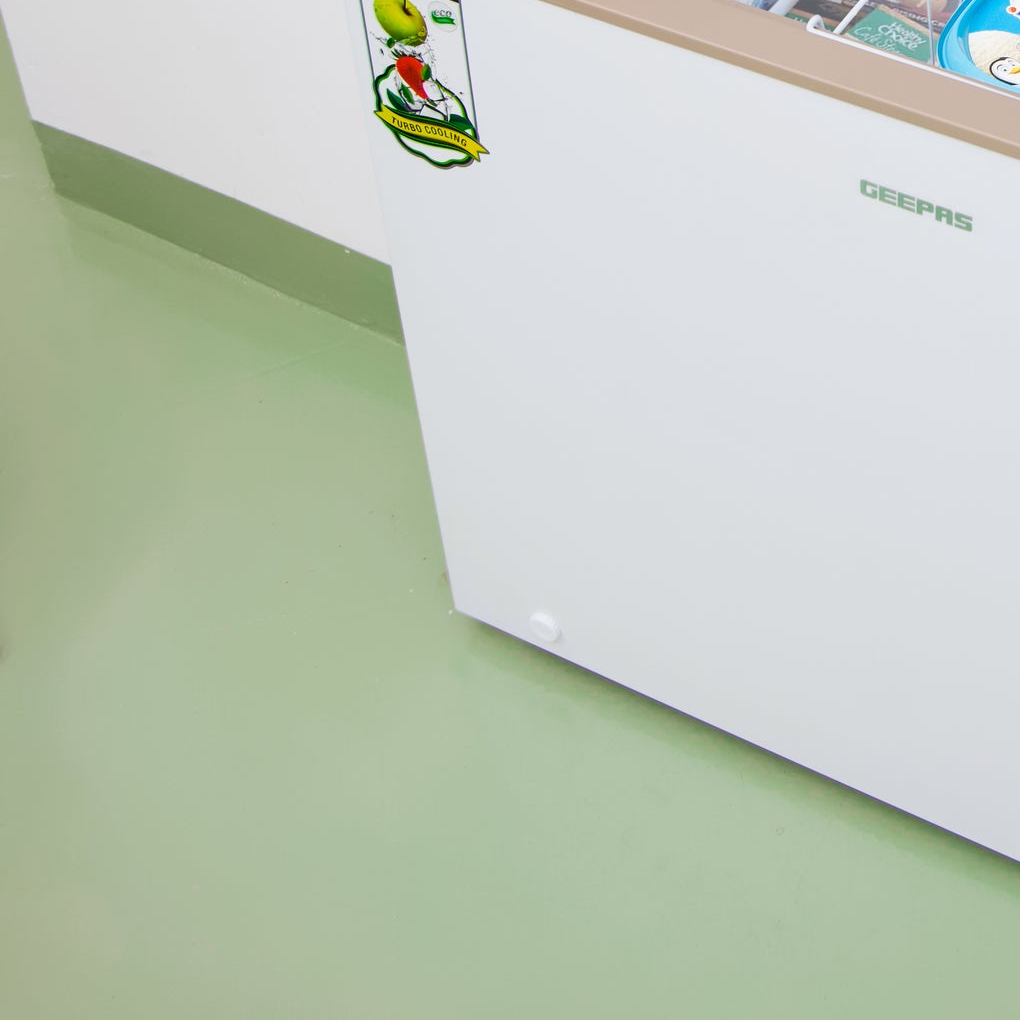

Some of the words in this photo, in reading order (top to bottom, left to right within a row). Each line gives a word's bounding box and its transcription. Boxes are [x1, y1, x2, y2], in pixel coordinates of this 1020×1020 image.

[432, 8, 452, 18] eco
[878, 25, 918, 51] Choice
[891, 22, 927, 46] Healthy
[391, 115, 423, 134] TURBO
[424, 124, 468, 148] COOLING
[860, 179, 973, 232] GEEPAS
